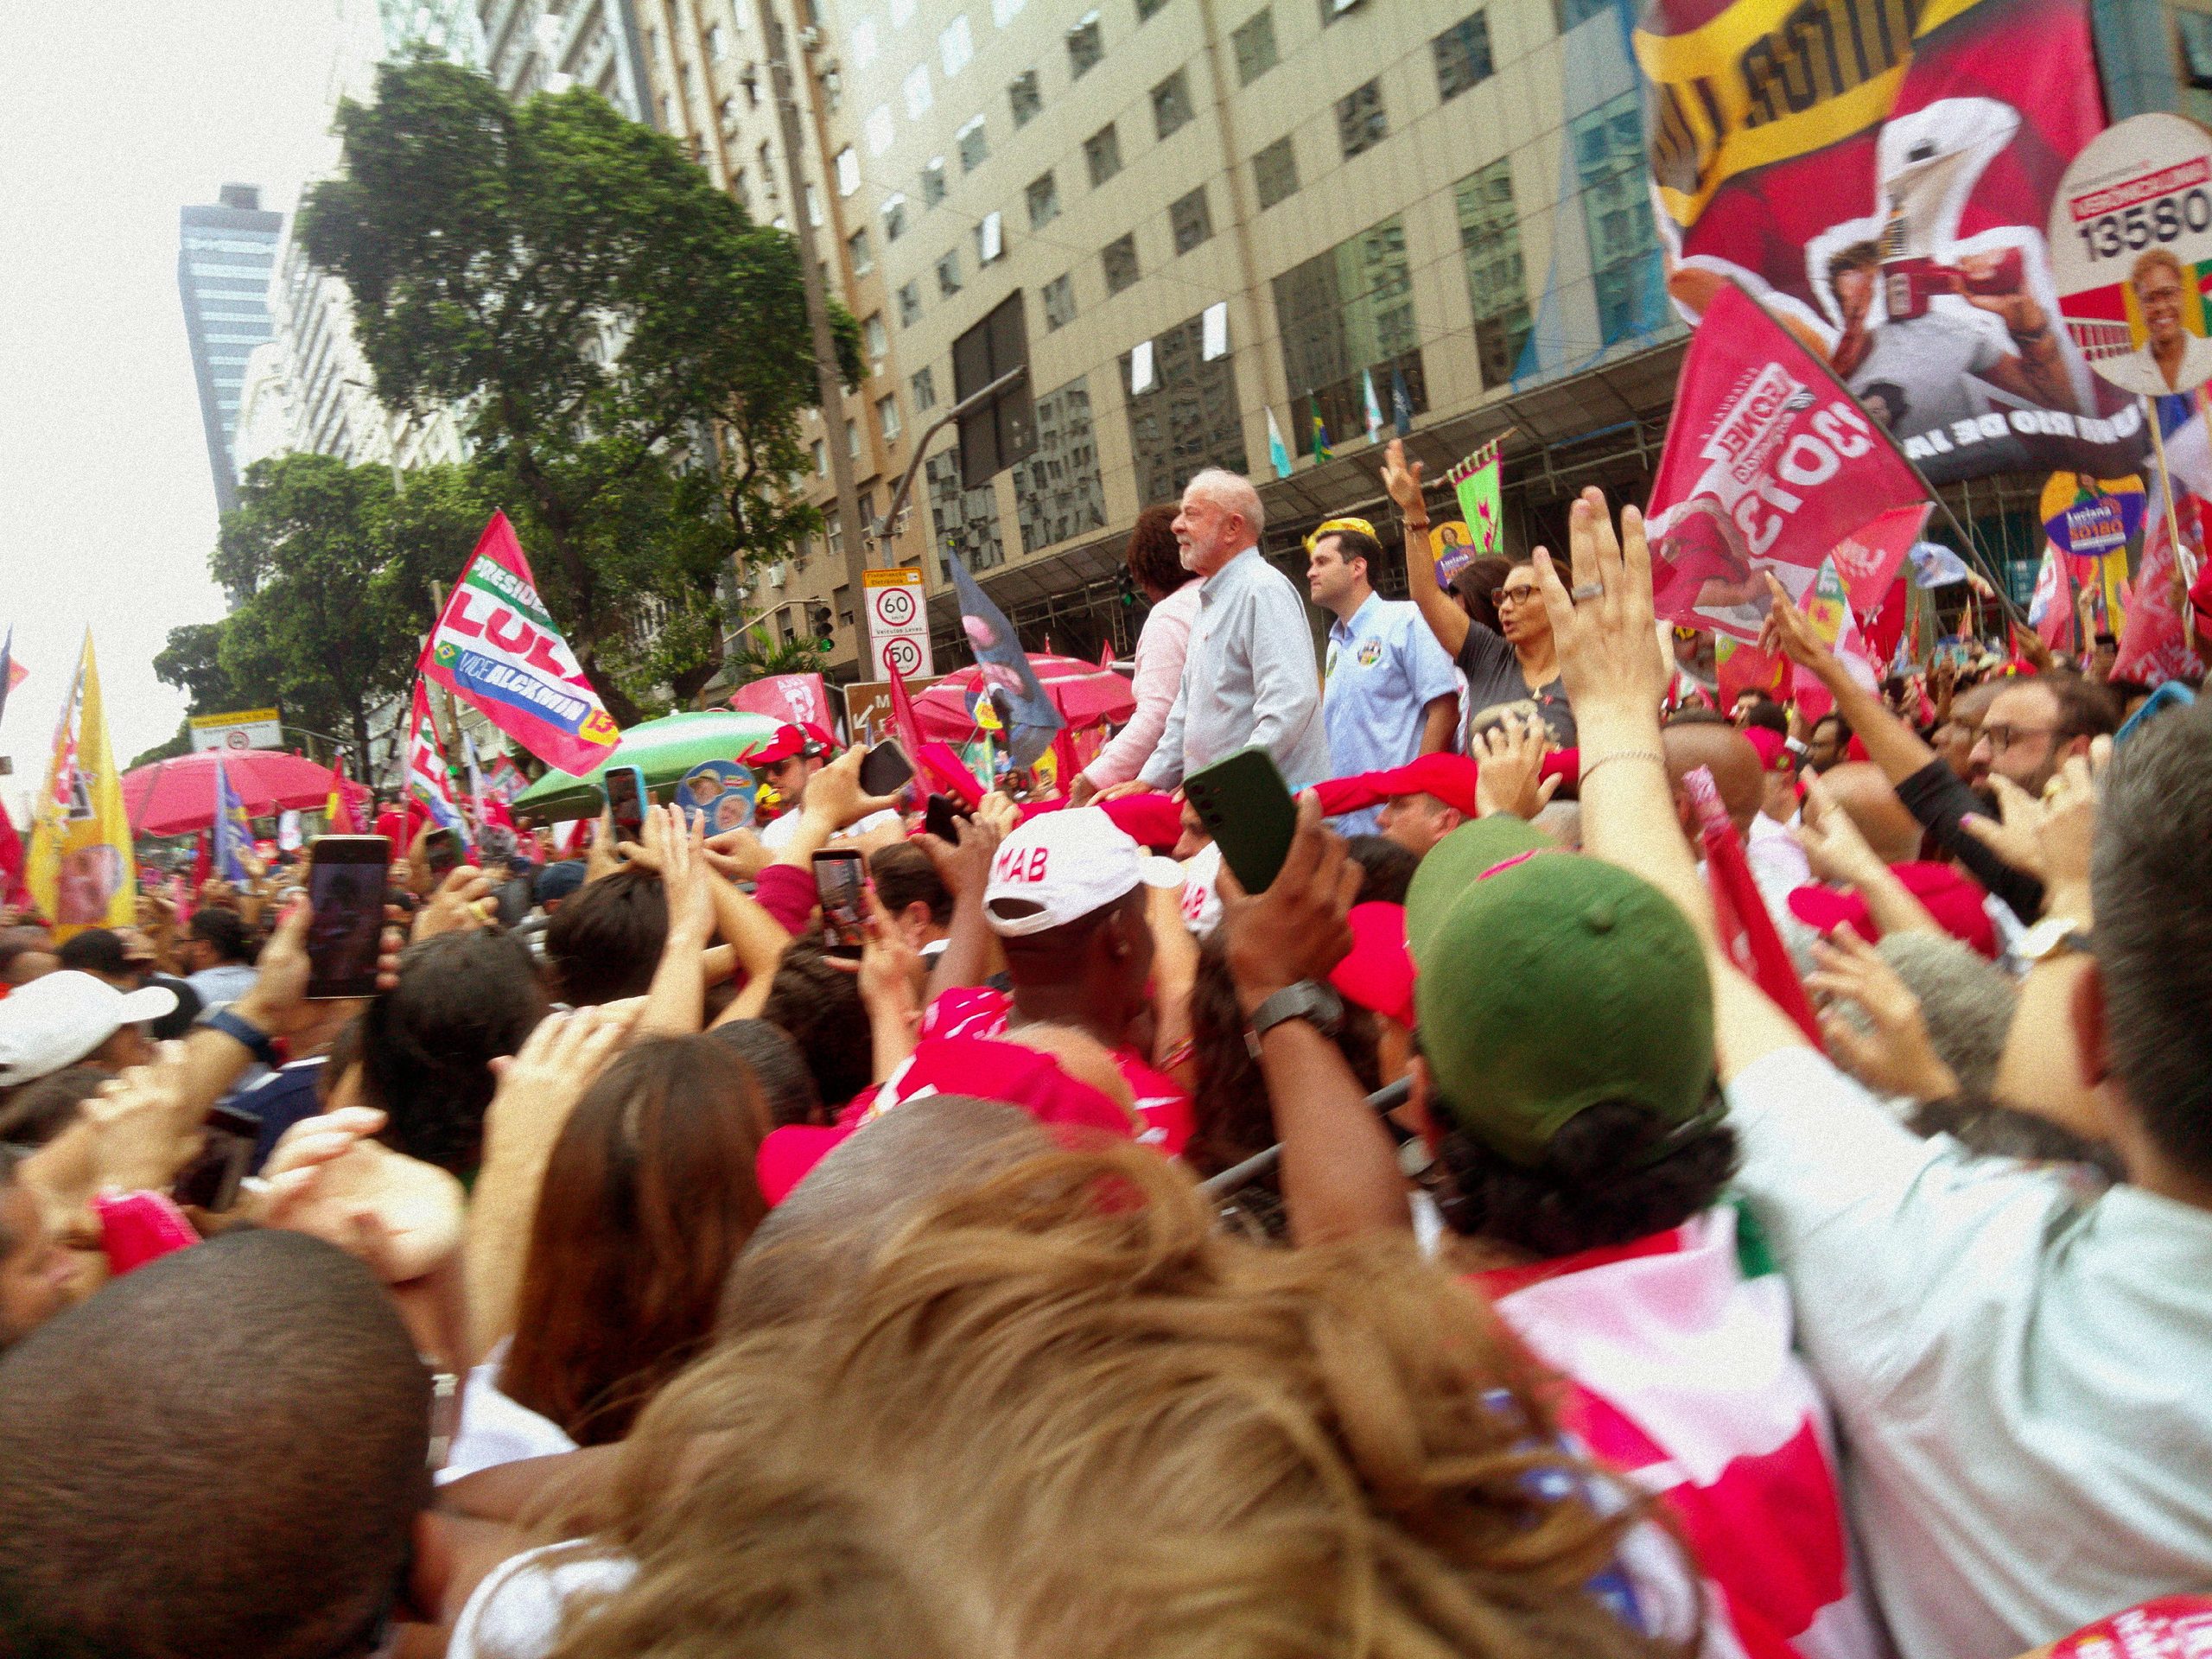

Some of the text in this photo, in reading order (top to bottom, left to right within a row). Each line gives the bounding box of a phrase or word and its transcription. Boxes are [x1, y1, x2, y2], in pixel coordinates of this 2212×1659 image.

[2077, 189, 2210, 262] 13580
[472, 556, 549, 616] PRESIDE
[884, 596, 908, 613] 60
[890, 645, 914, 664] 50
[459, 648, 588, 721] VICE ALCKMIN
[588, 709, 615, 733] 13
[996, 848, 1049, 883] MAB
